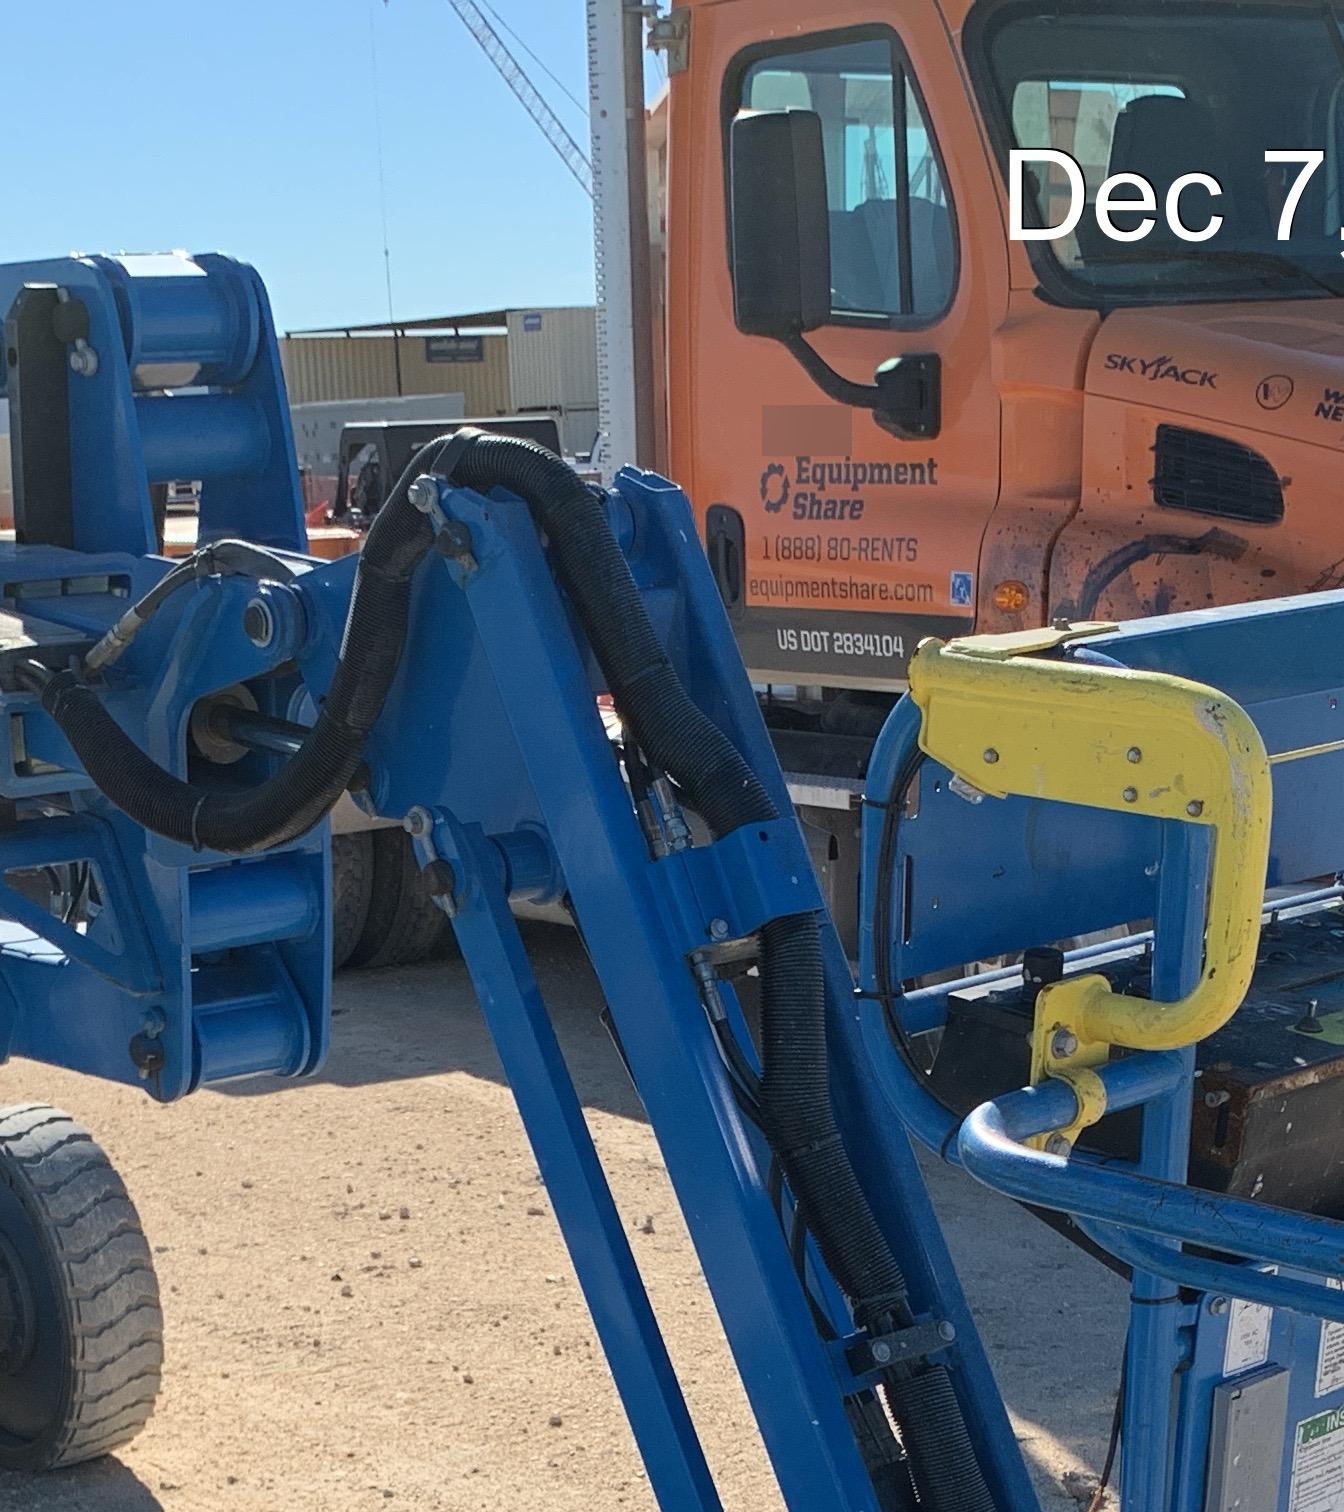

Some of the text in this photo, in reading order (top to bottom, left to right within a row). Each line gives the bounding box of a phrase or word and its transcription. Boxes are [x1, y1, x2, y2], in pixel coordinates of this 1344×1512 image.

[1104, 354, 1218, 389] SKYJACK
[795, 456, 938, 491] Equipment
[793, 492, 864, 521] Share
[762, 535, 918, 562] 1 (888) 80-RENTS
[750, 574, 933, 602] equipmentshare.com
[777, 628, 904, 657] US DOT 2834104
